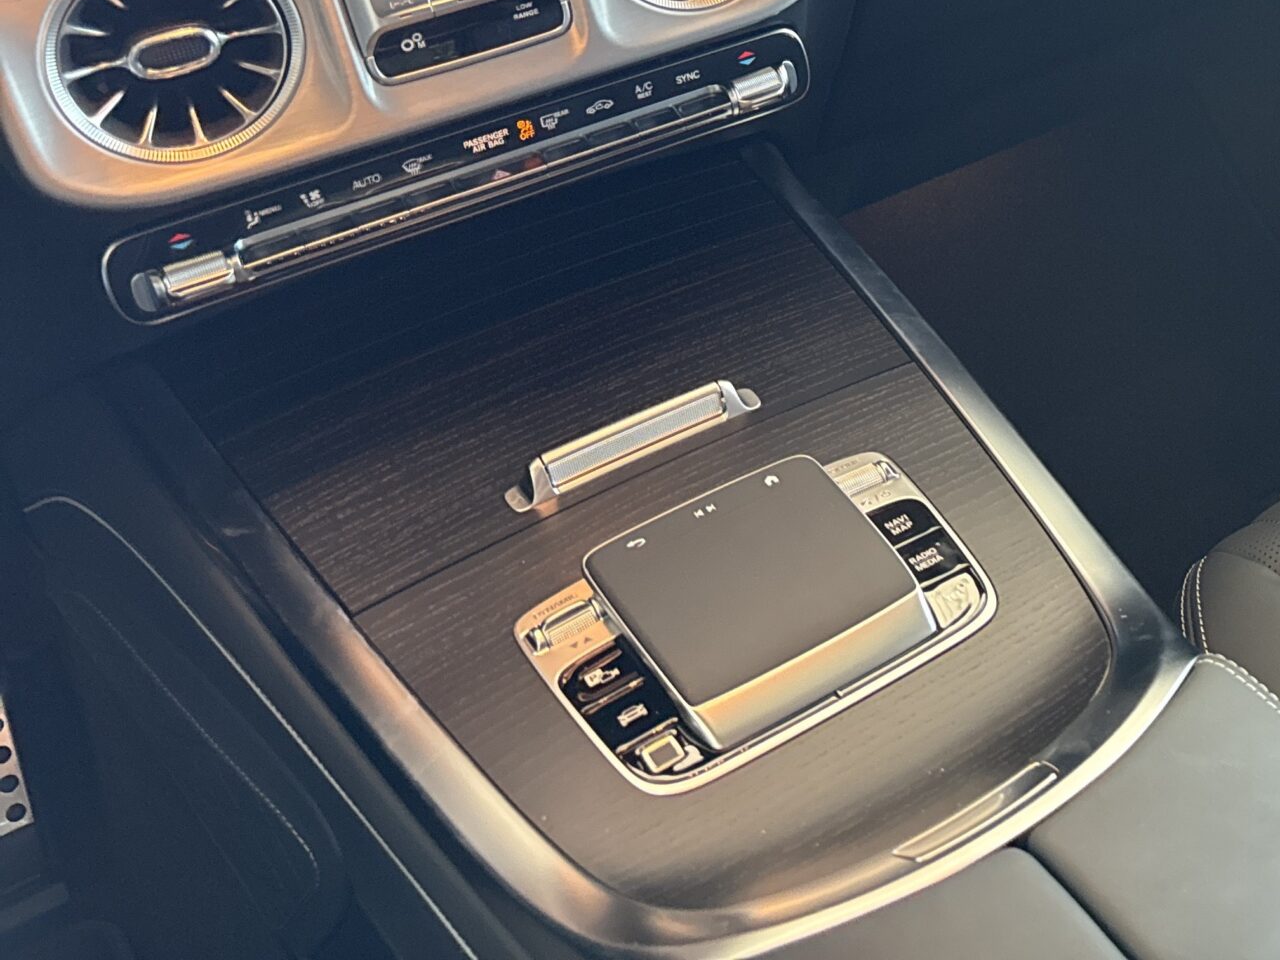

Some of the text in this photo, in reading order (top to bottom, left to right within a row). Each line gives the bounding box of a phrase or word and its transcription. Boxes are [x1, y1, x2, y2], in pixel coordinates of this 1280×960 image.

[515, 1, 534, 11] LOW
[512, 7, 540, 21] RANGE
[417, 39, 426, 48] M
[675, 70, 701, 85] SYNC
[635, 81, 654, 94] A/C
[637, 91, 653, 100] REST
[463, 128, 510, 149] PASSENGER
[520, 130, 536, 141] OFF
[472, 138, 505, 154] AIR BAG
[352, 173, 382, 190] AUTO
[884, 513, 911, 529] NAVI
[889, 520, 913, 536] MAP
[908, 547, 937, 565] RADIO
[914, 554, 944, 572] MEDIA
